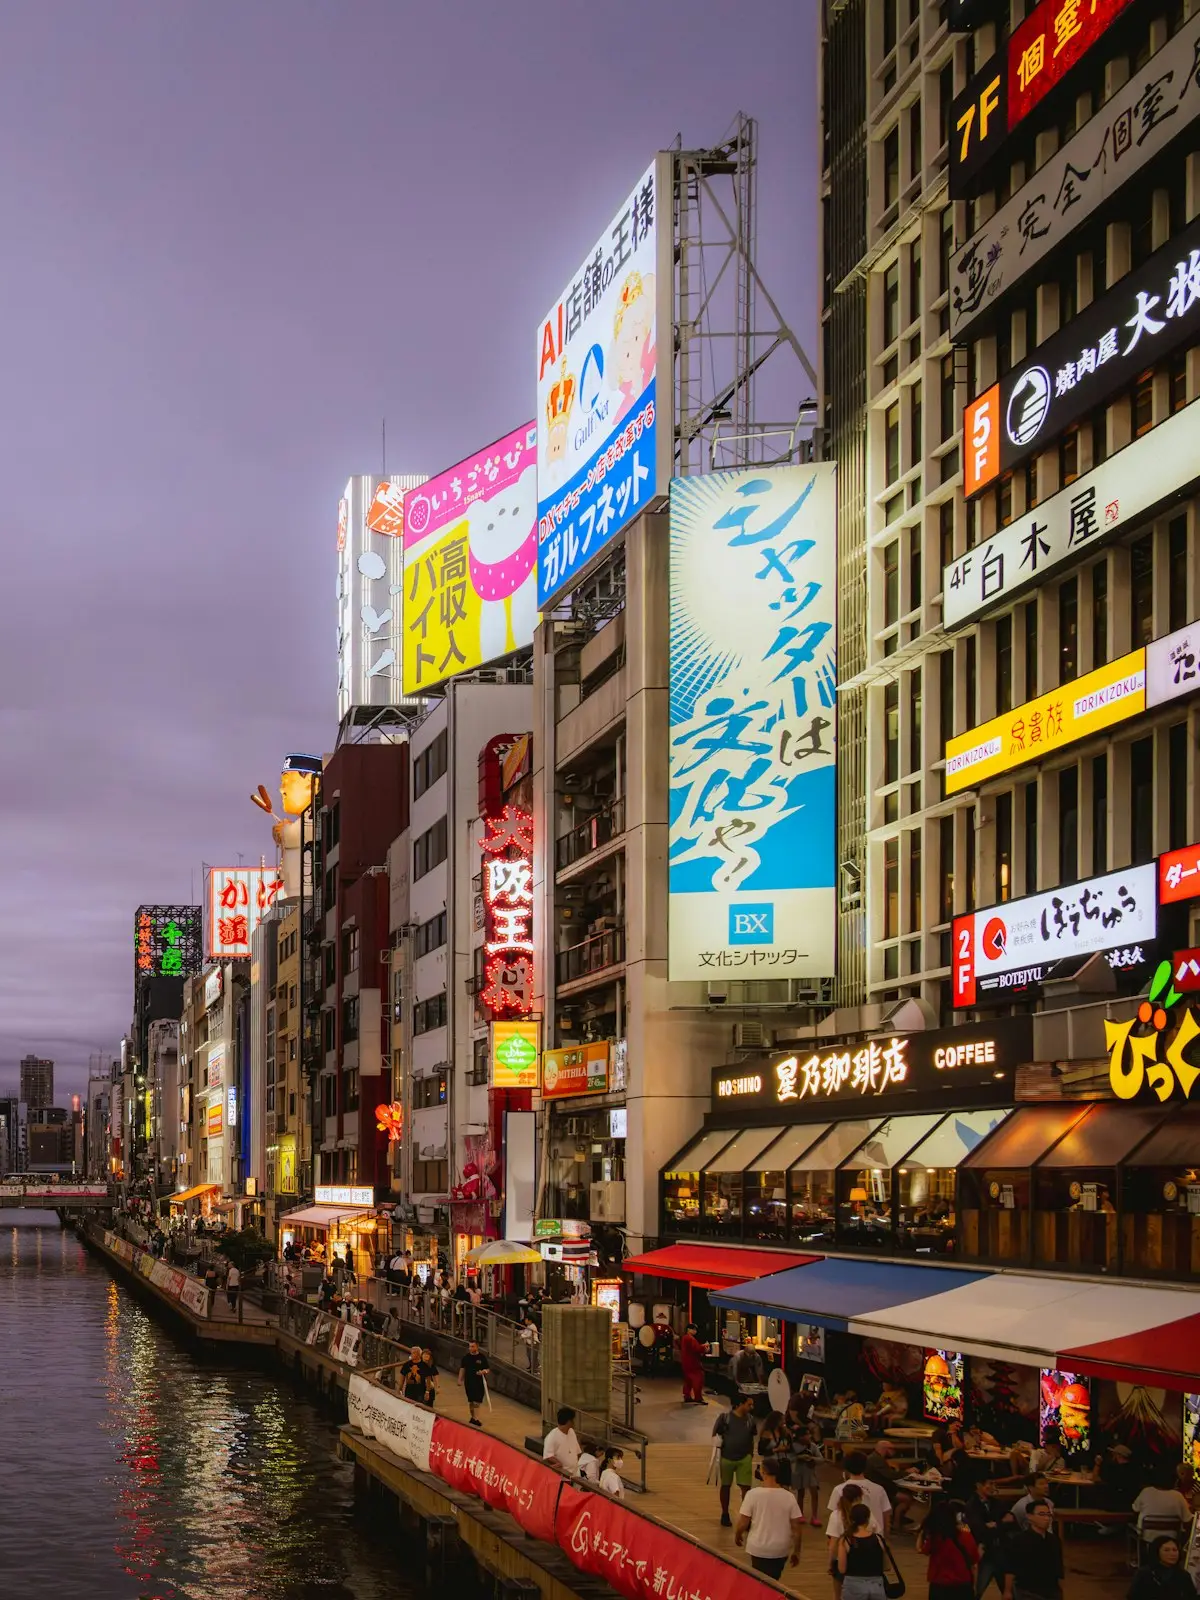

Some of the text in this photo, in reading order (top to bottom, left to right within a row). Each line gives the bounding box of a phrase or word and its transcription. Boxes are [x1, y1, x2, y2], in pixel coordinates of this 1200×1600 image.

[1017, 0, 1099, 92] 個室
[956, 75, 1001, 163] 7F
[539, 174, 655, 382] AI店舗の王様
[1055, 327, 1119, 399] 焼肉屋
[431, 441, 523, 510] いちごなび
[539, 400, 655, 544] DXでチェーン店を改革する
[972, 402, 992, 482] 5F
[543, 448, 648, 592] ガルフネット
[950, 486, 1100, 601] 4F 白木屋
[410, 551, 438, 684] バイト
[438, 535, 468, 674] 高収入
[1076, 676, 1138, 713] TORIKIZOKU
[947, 739, 996, 774] TORIKIZOKU
[1010, 701, 1064, 757] 鳥貴族
[1165, 859, 1200, 889] ダー
[478, 805, 534, 1013] 大阪王将
[734, 914, 768, 936] BX
[1040, 885, 1137, 942] ぼてぢゅう
[958, 929, 972, 995] 2F
[999, 966, 1042, 988] BOTEJYU
[558, 1067, 587, 1080] MITHILA
[718, 1075, 762, 1097] HOSHINO
[775, 1038, 909, 1101] 星乃珈琲店
[934, 1040, 996, 1069] COFFEE
